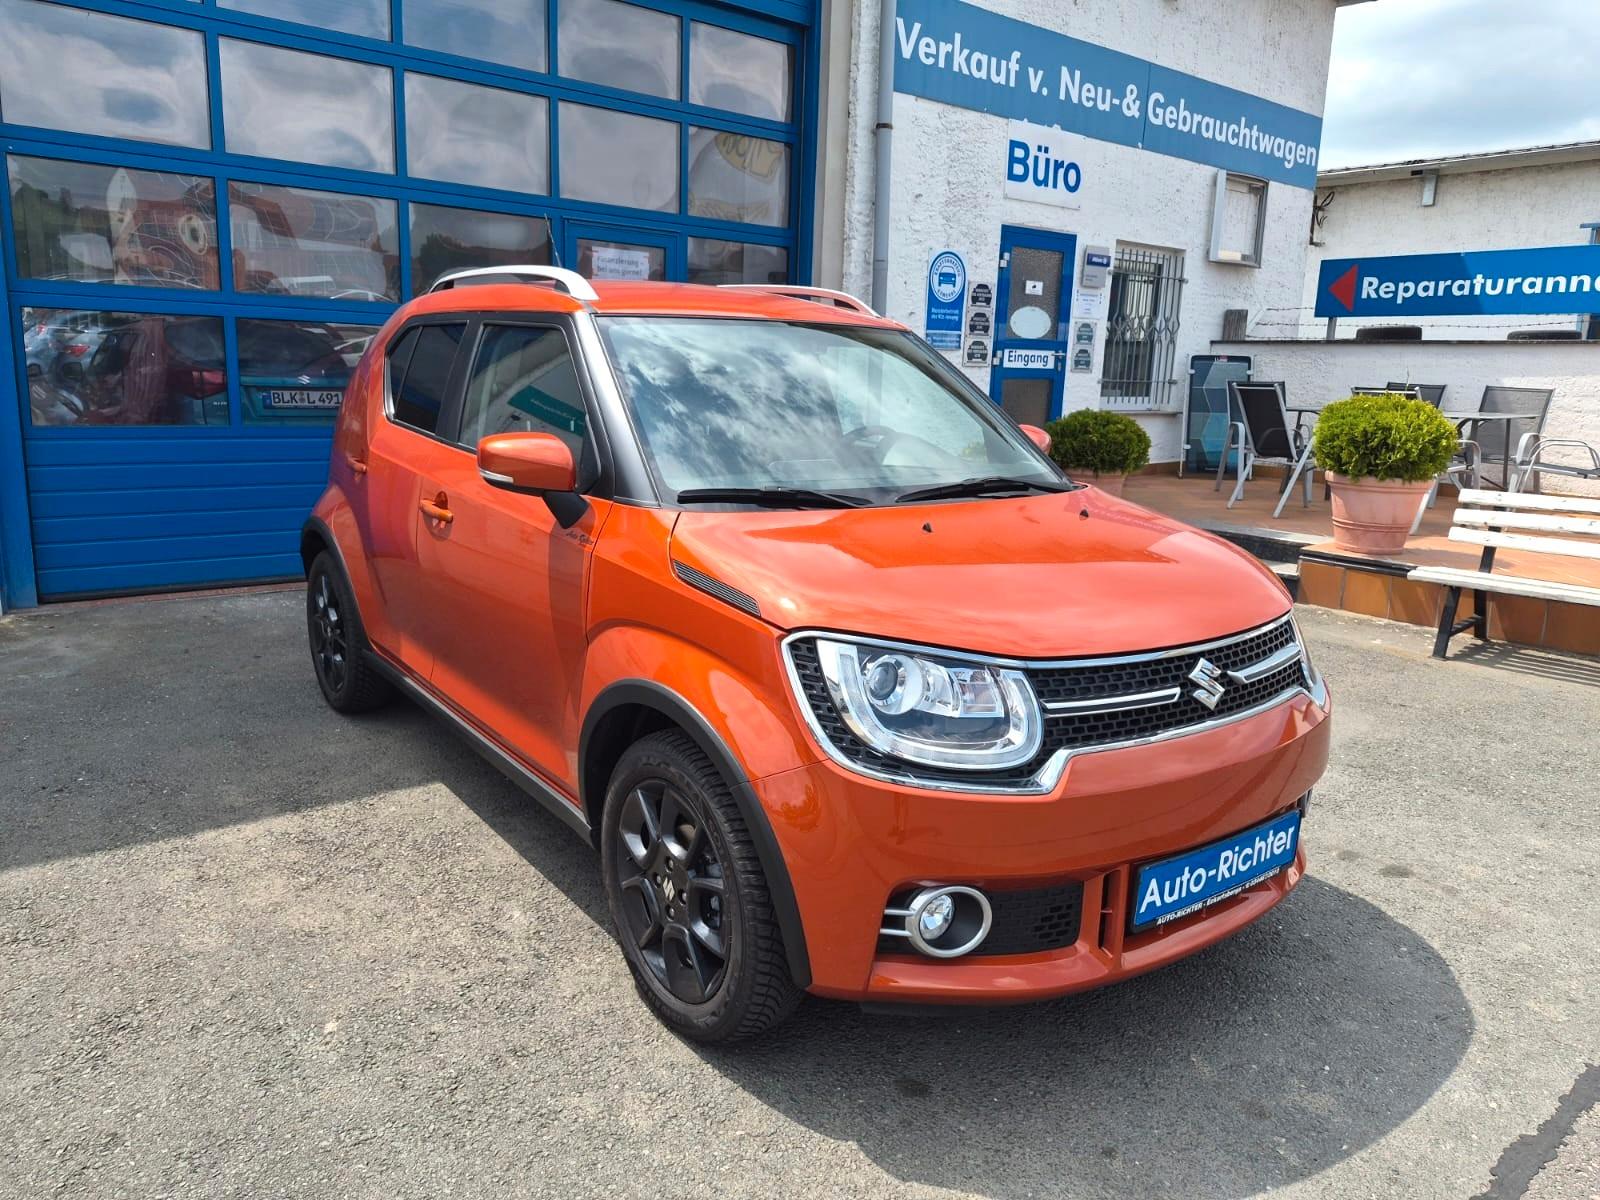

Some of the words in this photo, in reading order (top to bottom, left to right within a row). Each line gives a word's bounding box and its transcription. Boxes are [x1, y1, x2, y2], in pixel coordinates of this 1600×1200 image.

[896, 17, 1021, 88] Verkauf
[1028, 66, 1049, 96] v.
[1147, 92, 1318, 170] Gebrauchtwagen
[1006, 139, 1081, 194] Büro
[1007, 350, 1049, 367] Eingang
[272, 391, 298, 404] BLK
[318, 392, 341, 406] 491
[1139, 825, 1295, 914] Auto-Richter
[1156, 902, 1203, 926] AUTO-RICHTER
